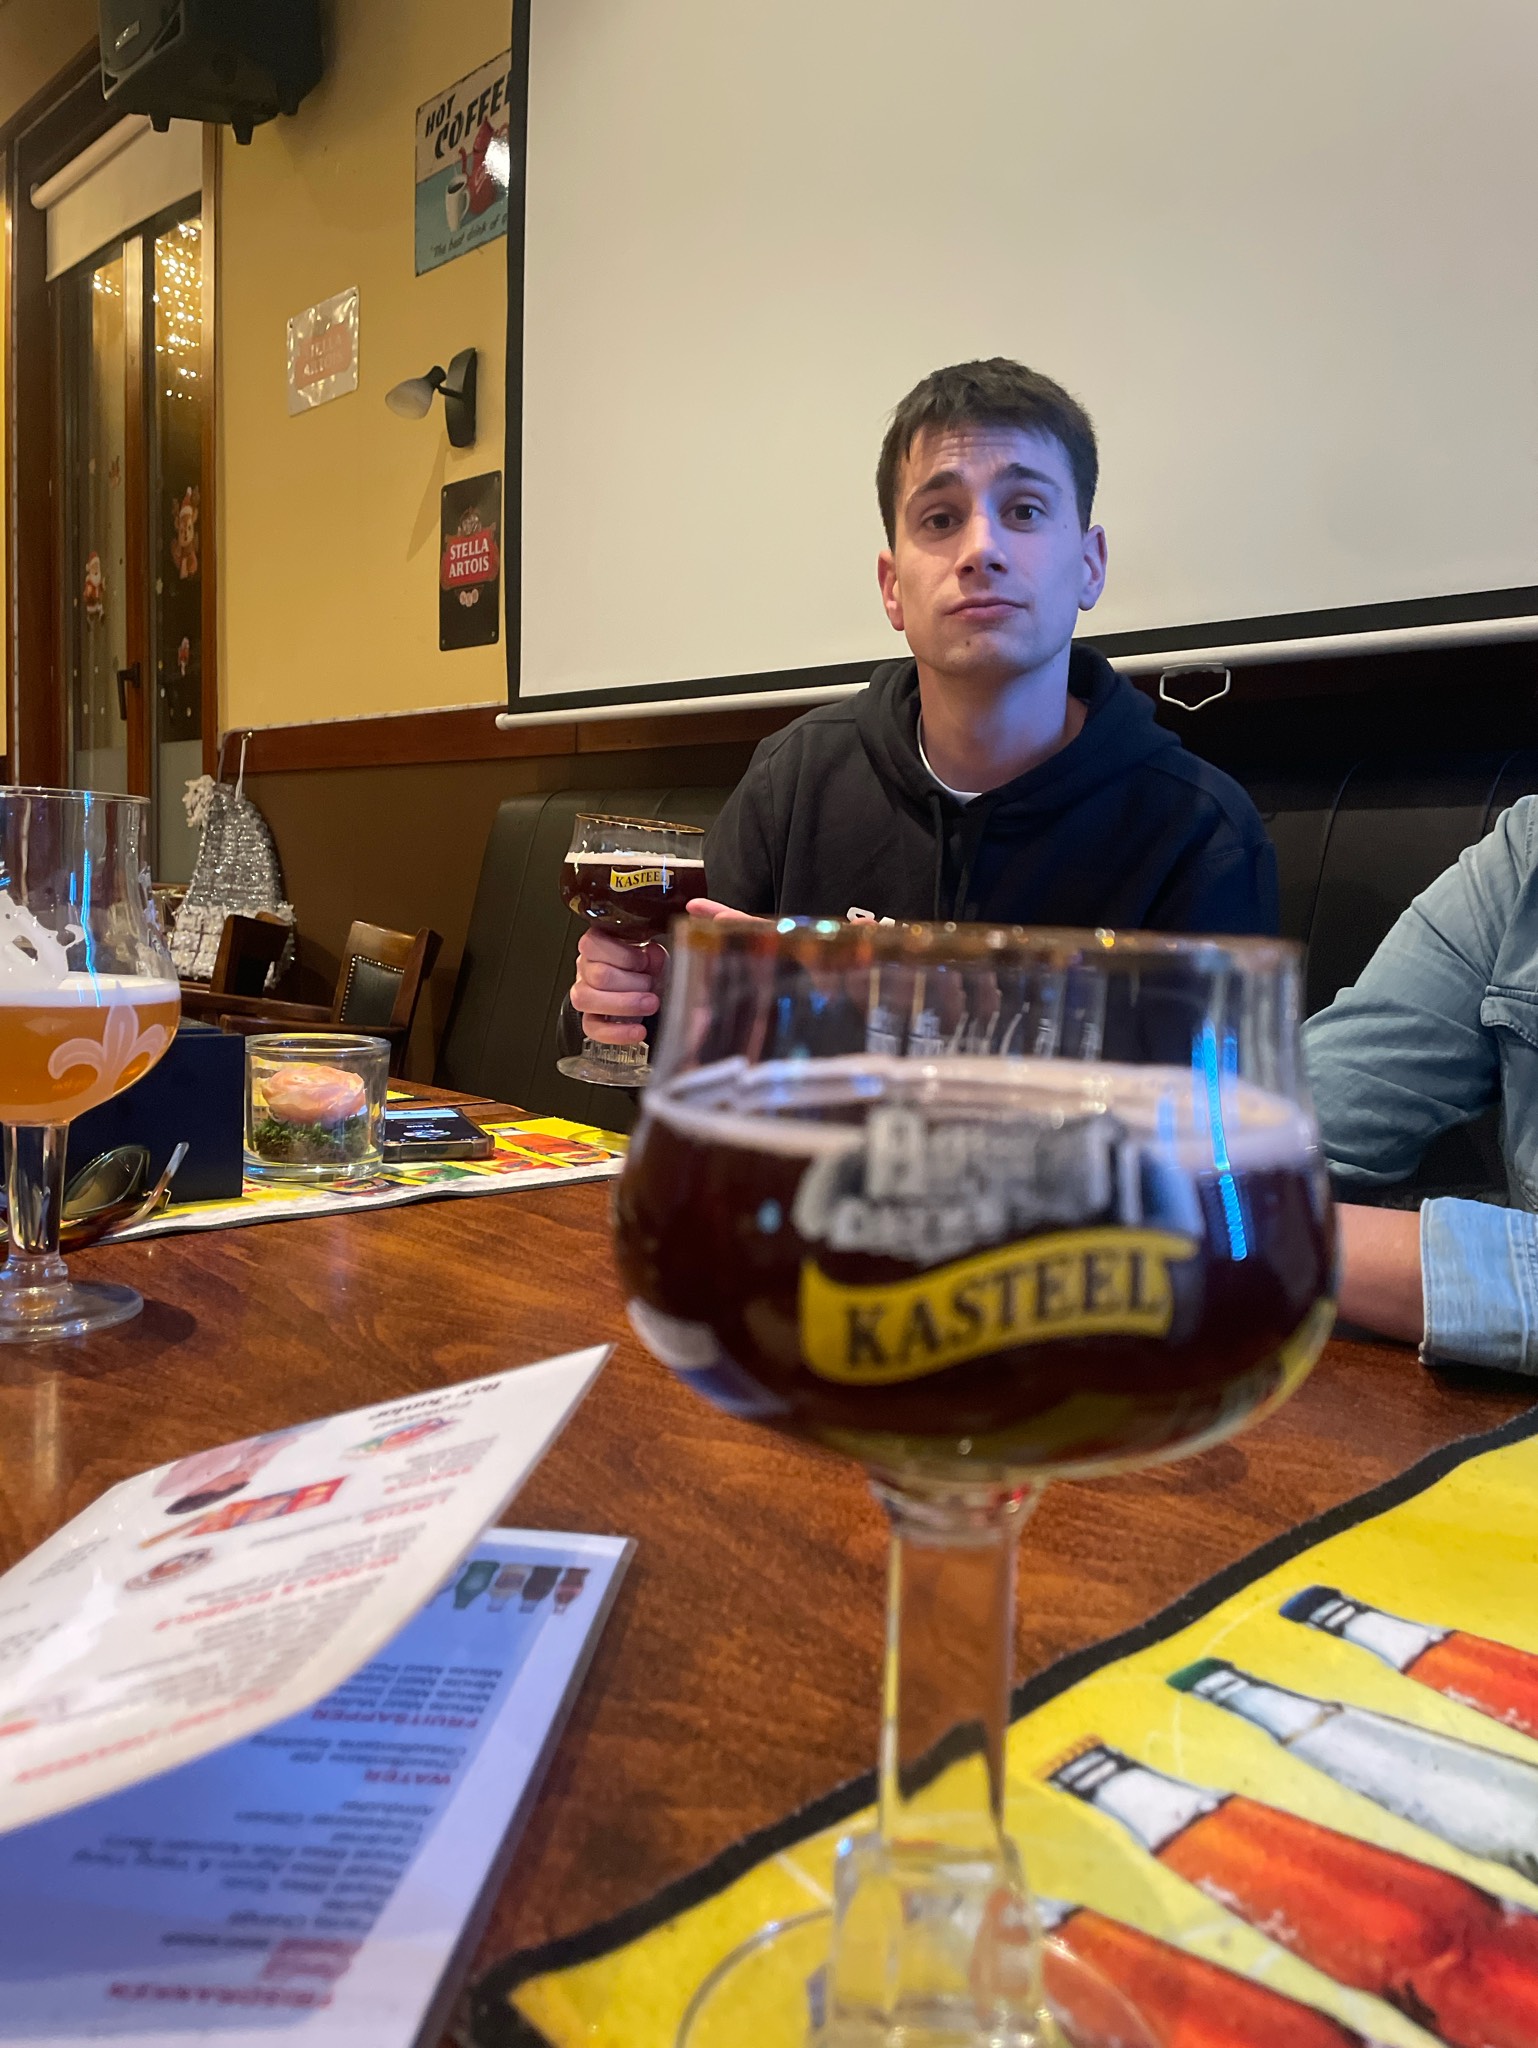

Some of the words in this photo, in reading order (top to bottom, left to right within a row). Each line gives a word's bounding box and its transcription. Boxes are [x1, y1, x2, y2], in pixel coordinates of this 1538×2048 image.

[425, 93, 456, 138] HOT
[450, 538, 490, 561] STELLA
[449, 555, 490, 578] ARTOIS
[615, 869, 669, 889] KASTEEL
[843, 1249, 1165, 1370] KASTEEL
